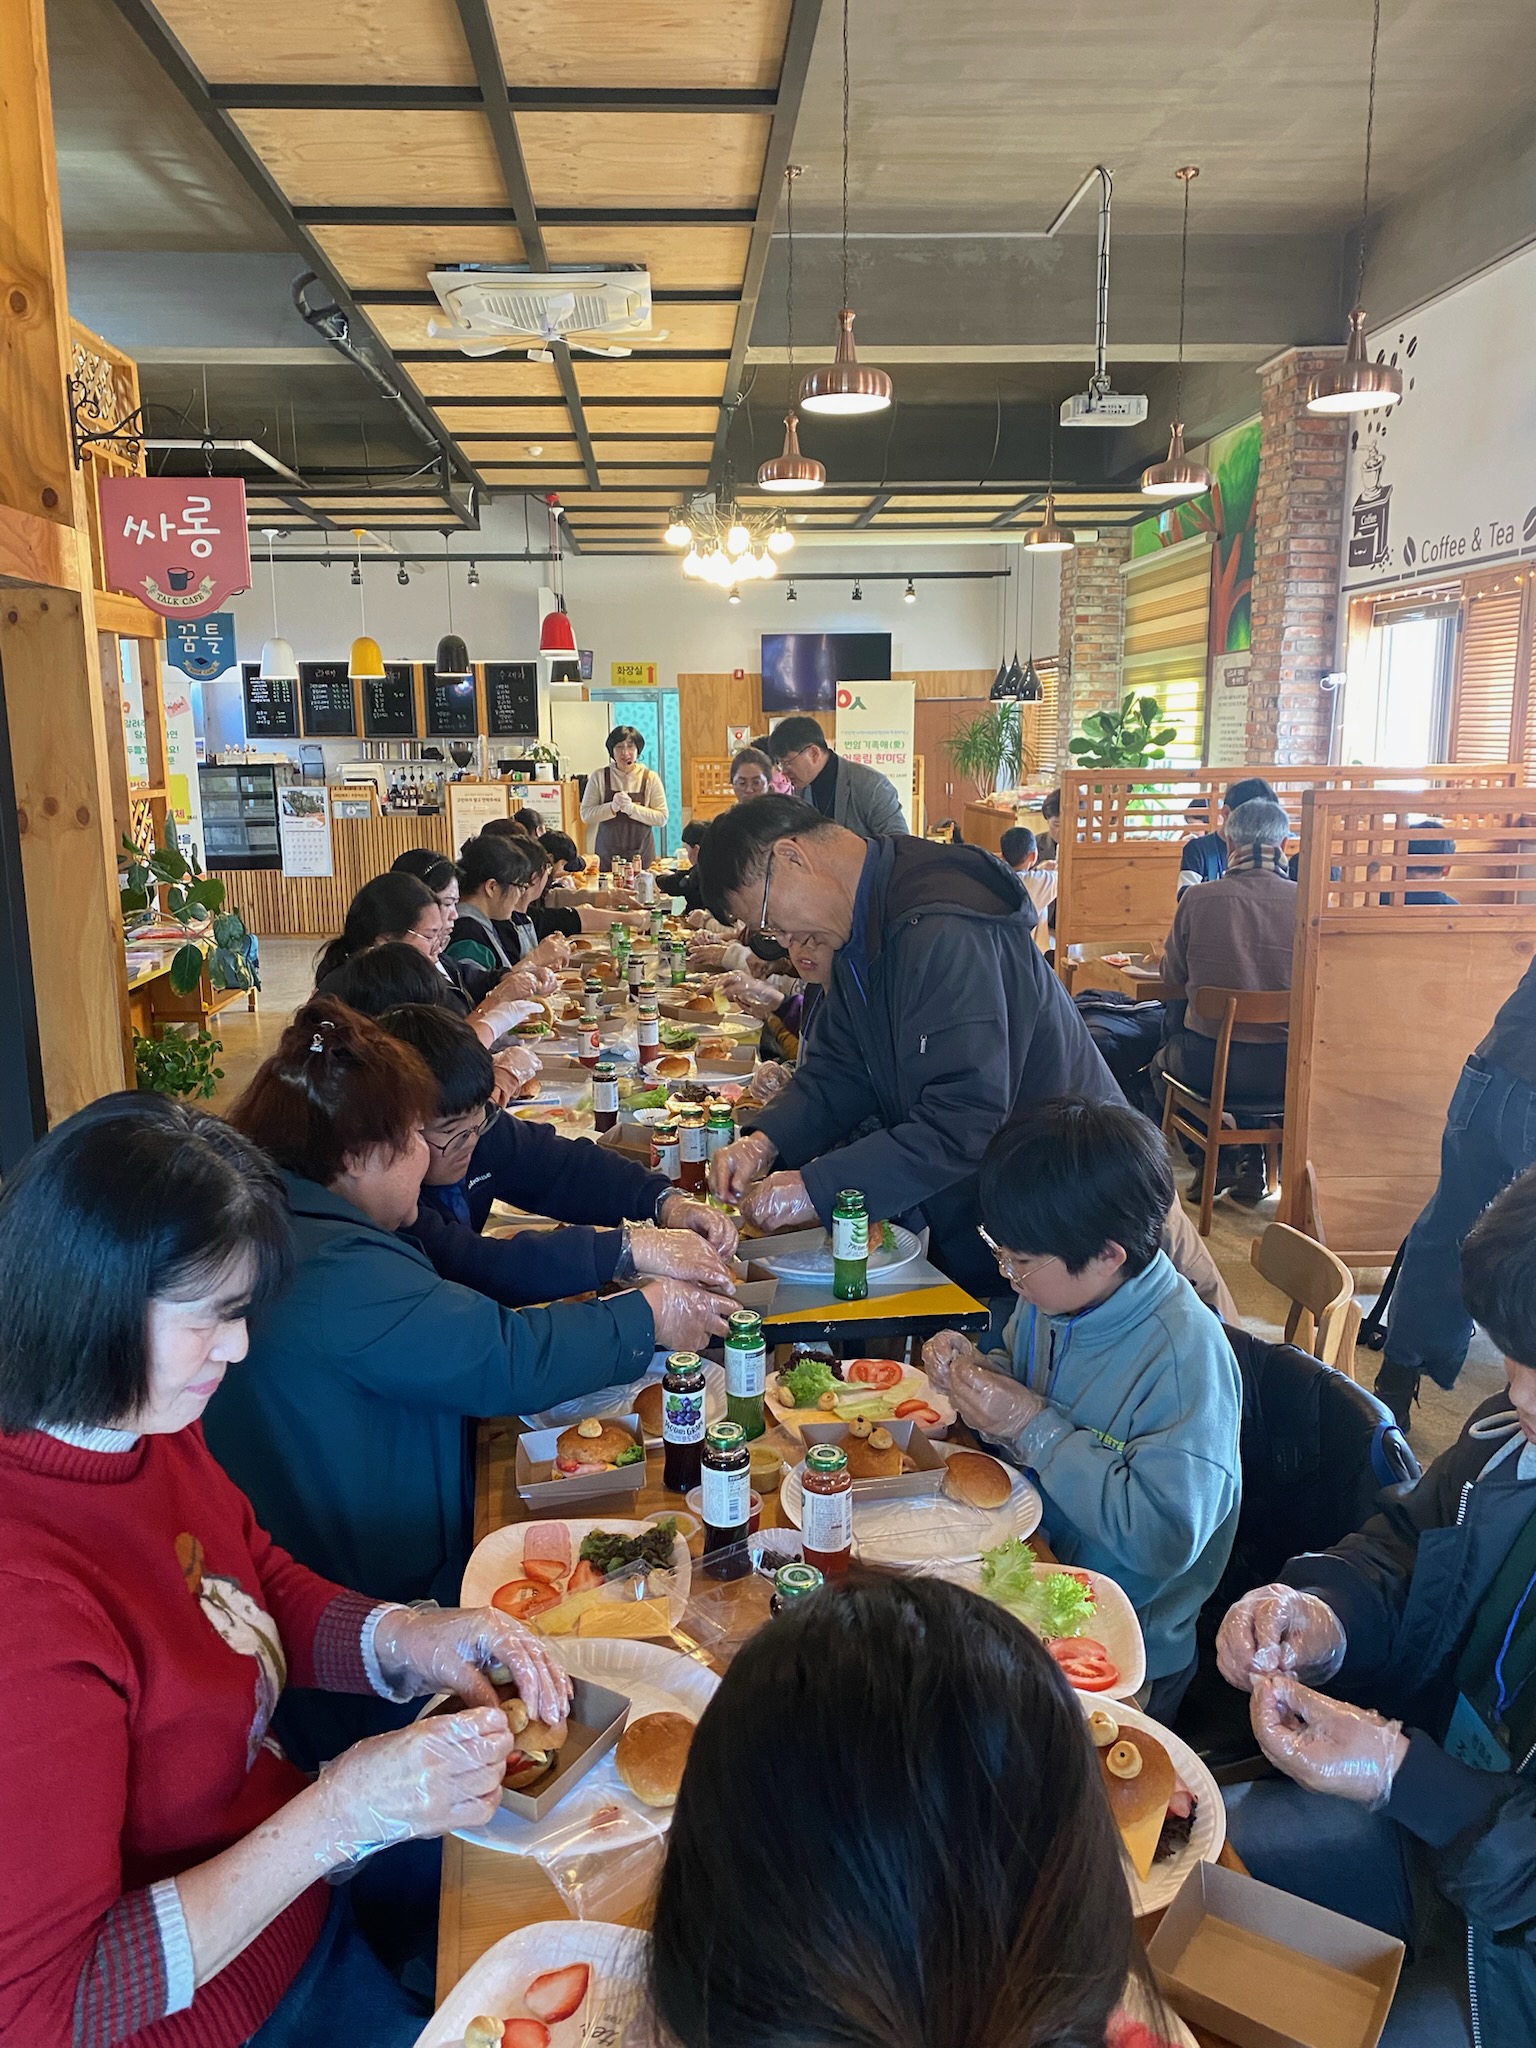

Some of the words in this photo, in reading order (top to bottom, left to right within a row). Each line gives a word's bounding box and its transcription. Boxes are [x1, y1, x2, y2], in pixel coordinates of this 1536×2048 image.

[1361, 512, 1377, 525] Coffee
[123, 496, 221, 558] 싸롱
[1421, 535, 1466, 563] Coffee
[1471, 526, 1482, 552] &
[1489, 521, 1514, 548] Tea
[157, 594, 180, 606] TALK
[182, 594, 205, 606] CAFE
[178, 623, 223, 654] 꿈틀
[617, 665, 643, 676] 화장실
[875, 753, 907, 765] 한마당
